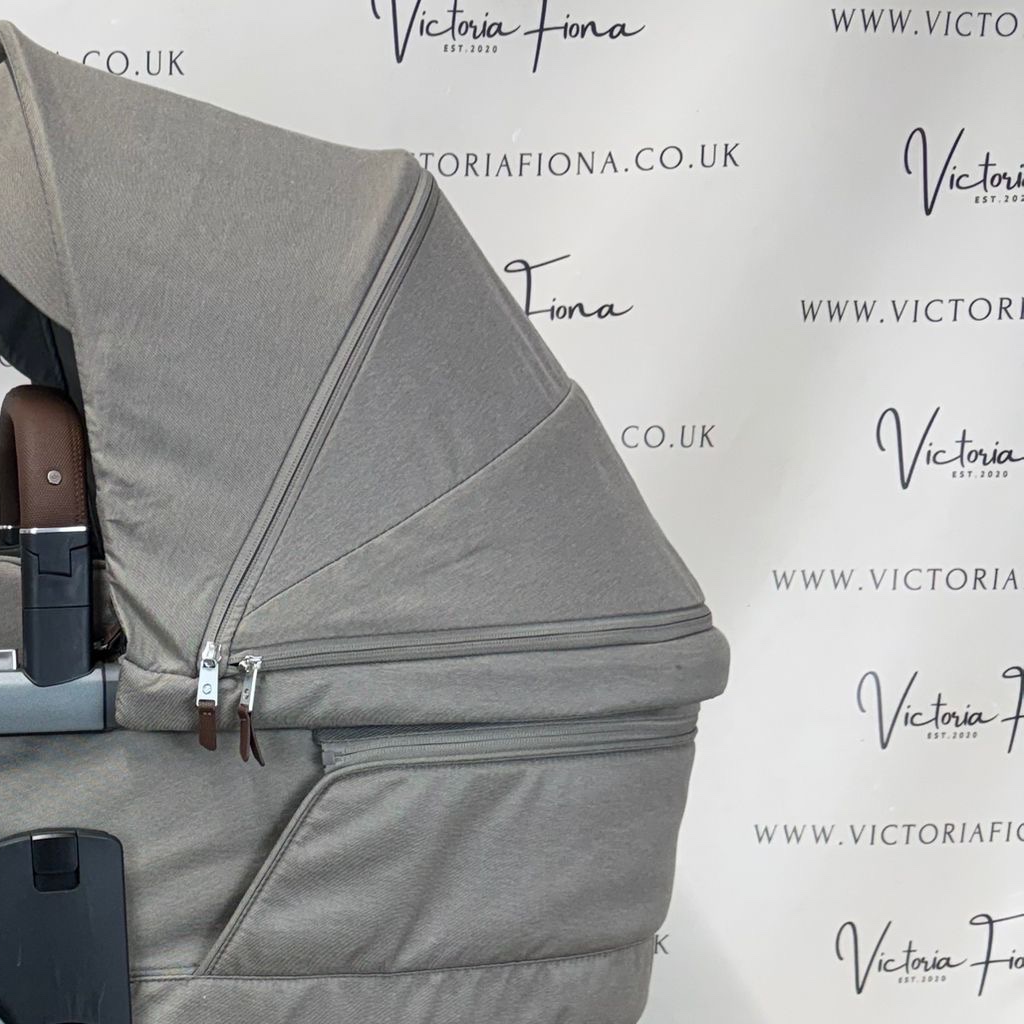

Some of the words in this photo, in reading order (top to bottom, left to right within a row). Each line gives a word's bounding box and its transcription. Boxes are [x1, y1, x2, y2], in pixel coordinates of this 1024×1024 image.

[443, 44, 499, 53] EST.2020
[411, 143, 741, 178] TORIAFIONA.CO.UK
[904, 127, 1024, 217] Victori
[504, 254, 634, 321] Fiona
[876, 406, 1024, 490] Victoria
[952, 470, 1008, 479] EST.2020
[856, 670, 1000, 750] Victoria
[927, 731, 978, 740] EST.2020
[835, 920, 968, 995] Victoria
